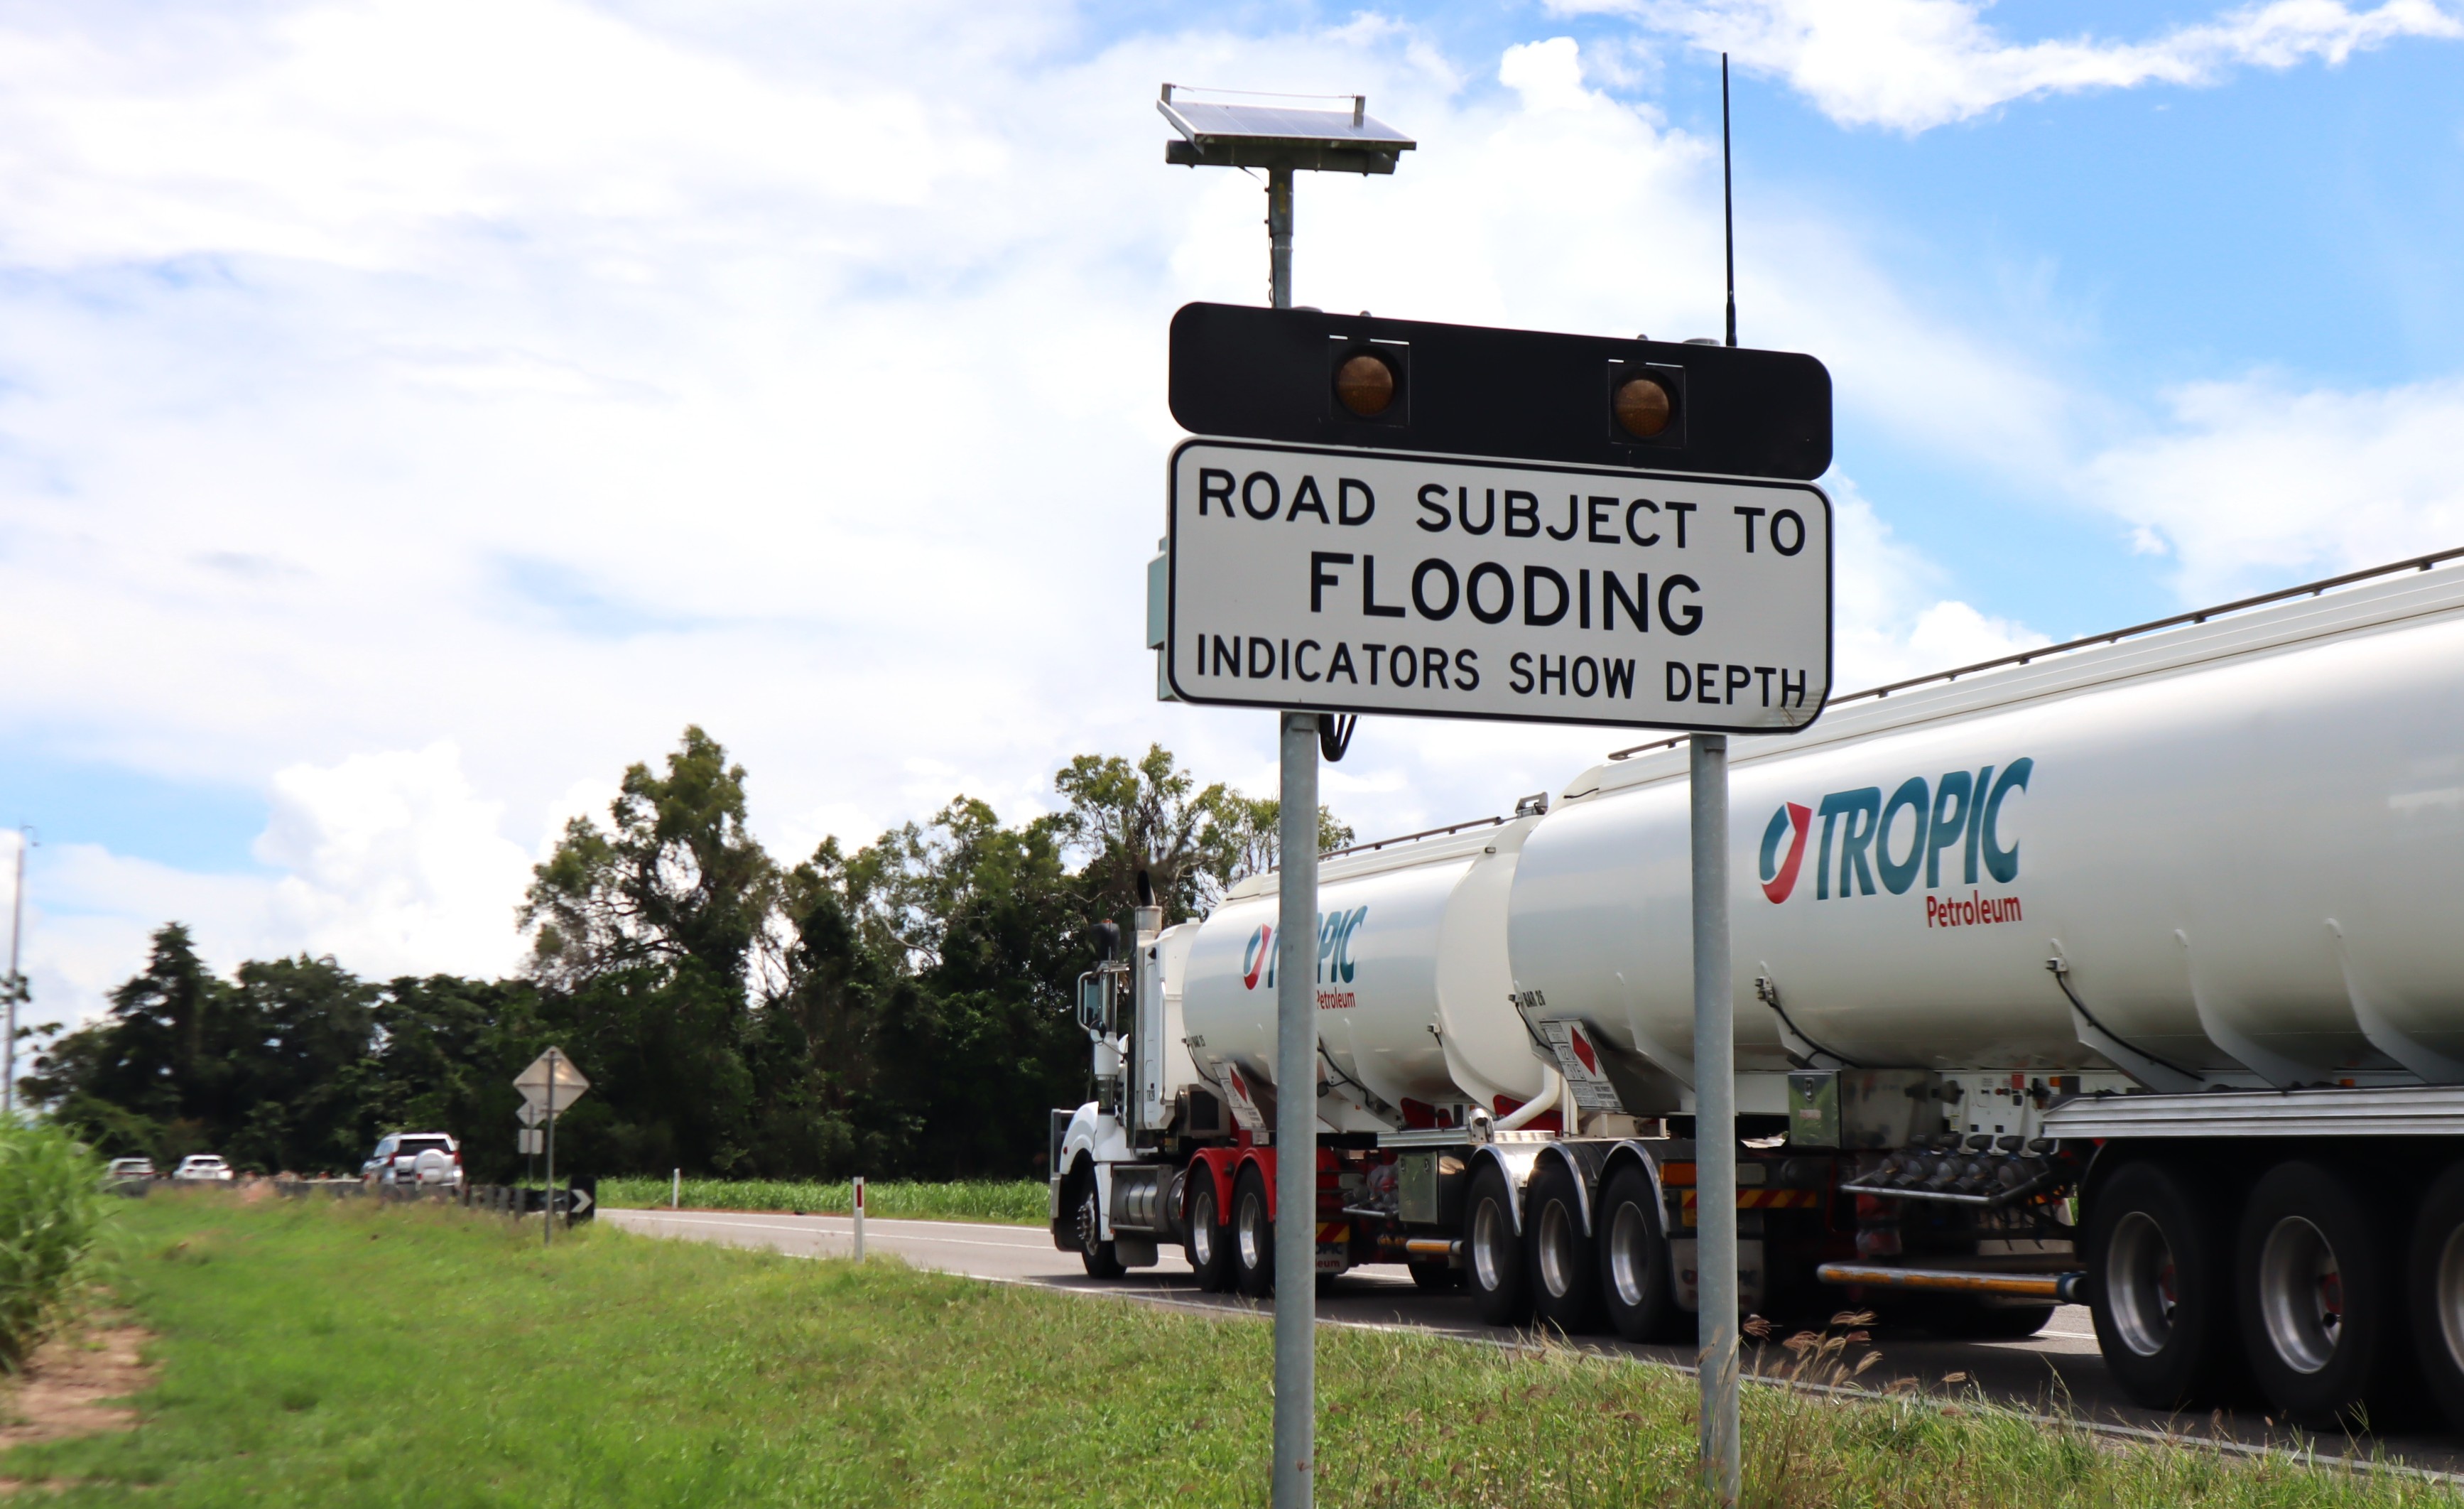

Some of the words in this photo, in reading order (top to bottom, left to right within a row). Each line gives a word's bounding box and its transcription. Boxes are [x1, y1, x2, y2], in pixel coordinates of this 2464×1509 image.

[1199, 467, 1375, 526] ROAD
[1416, 483, 1697, 549] SUBJECT
[1734, 506, 1806, 557] TO
[1310, 551, 1703, 637] FLOODING
[1198, 633, 1480, 691] INDICATORS
[1509, 651, 1636, 700] SHOW
[1666, 661, 1806, 708] DEPTH
[1816, 757, 2034, 901] TROPIC
[1926, 889, 2023, 928] Petroleum
